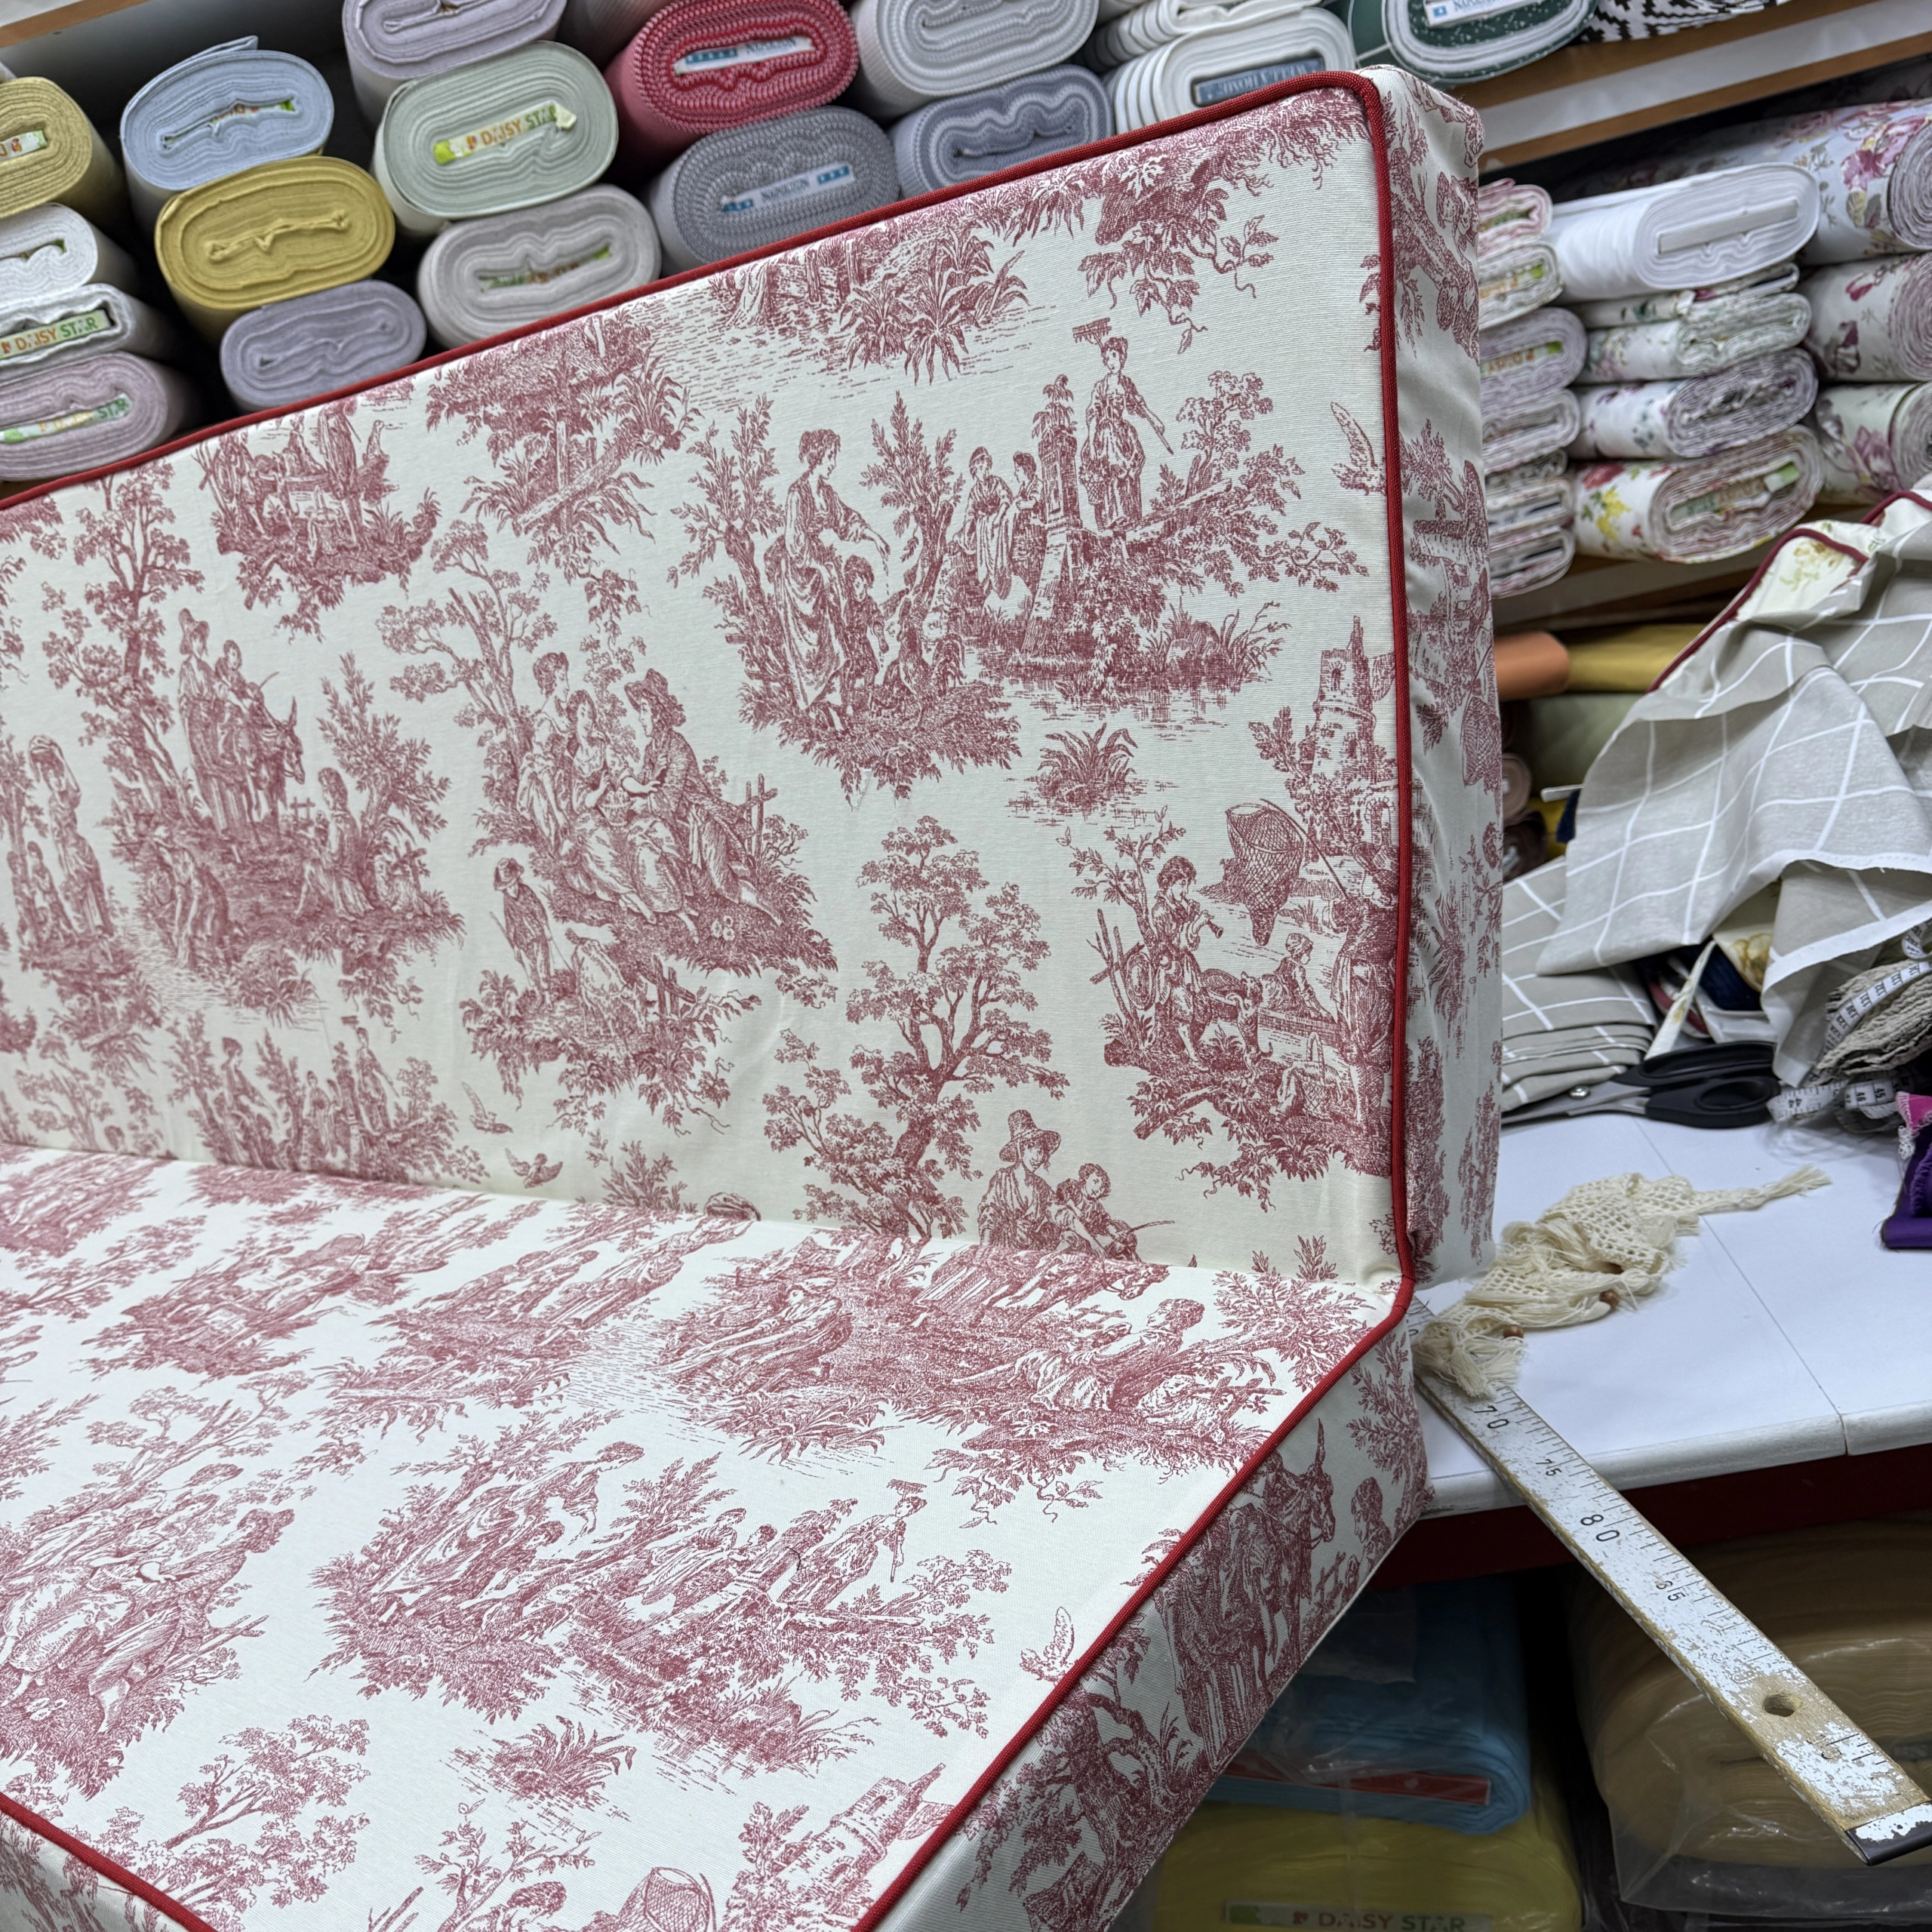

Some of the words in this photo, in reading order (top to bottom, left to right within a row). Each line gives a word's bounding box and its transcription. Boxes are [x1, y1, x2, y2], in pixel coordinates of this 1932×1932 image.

[480, 119, 522, 145] DAISY
[14, 328, 57, 351] DAISY
[60, 316, 99, 338] STAR
[1473, 1404, 1509, 1429] 70
[1536, 1458, 1562, 1477] 75
[1580, 1514, 1620, 1542] 80
[1318, 1912, 1394, 1930] DAISY
[1401, 1915, 1466, 1932] STAR
